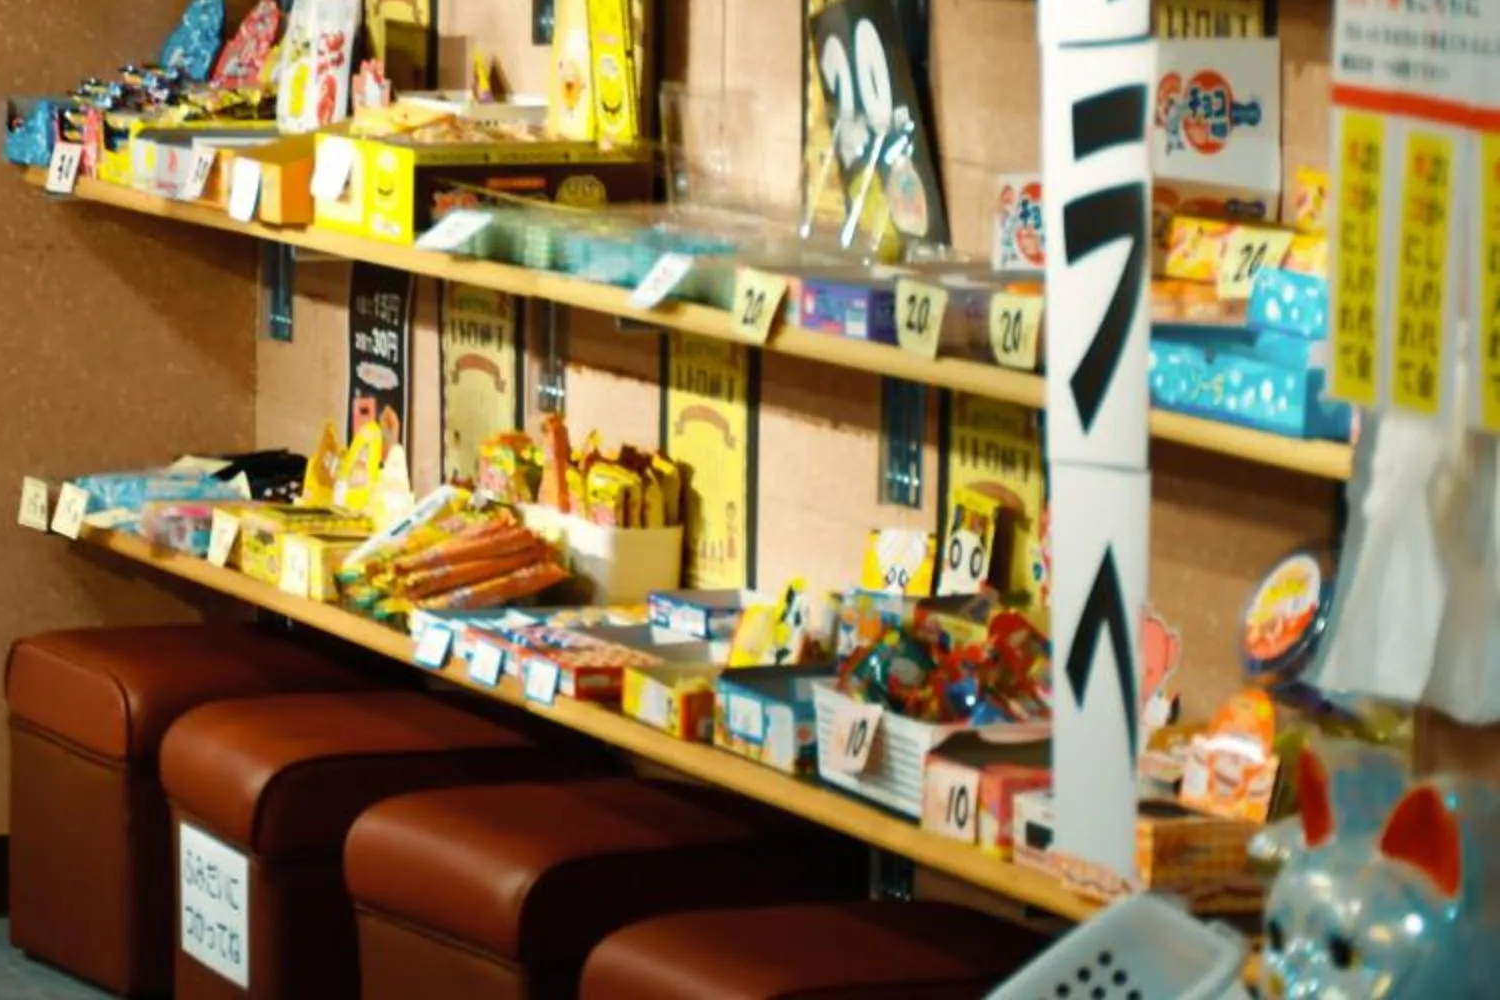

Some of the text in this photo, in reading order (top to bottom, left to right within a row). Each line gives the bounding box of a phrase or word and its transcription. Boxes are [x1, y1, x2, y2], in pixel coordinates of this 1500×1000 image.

[1001, 310, 1023, 354] 20
[845, 717, 868, 758] 10
[946, 784, 970, 830] 10
